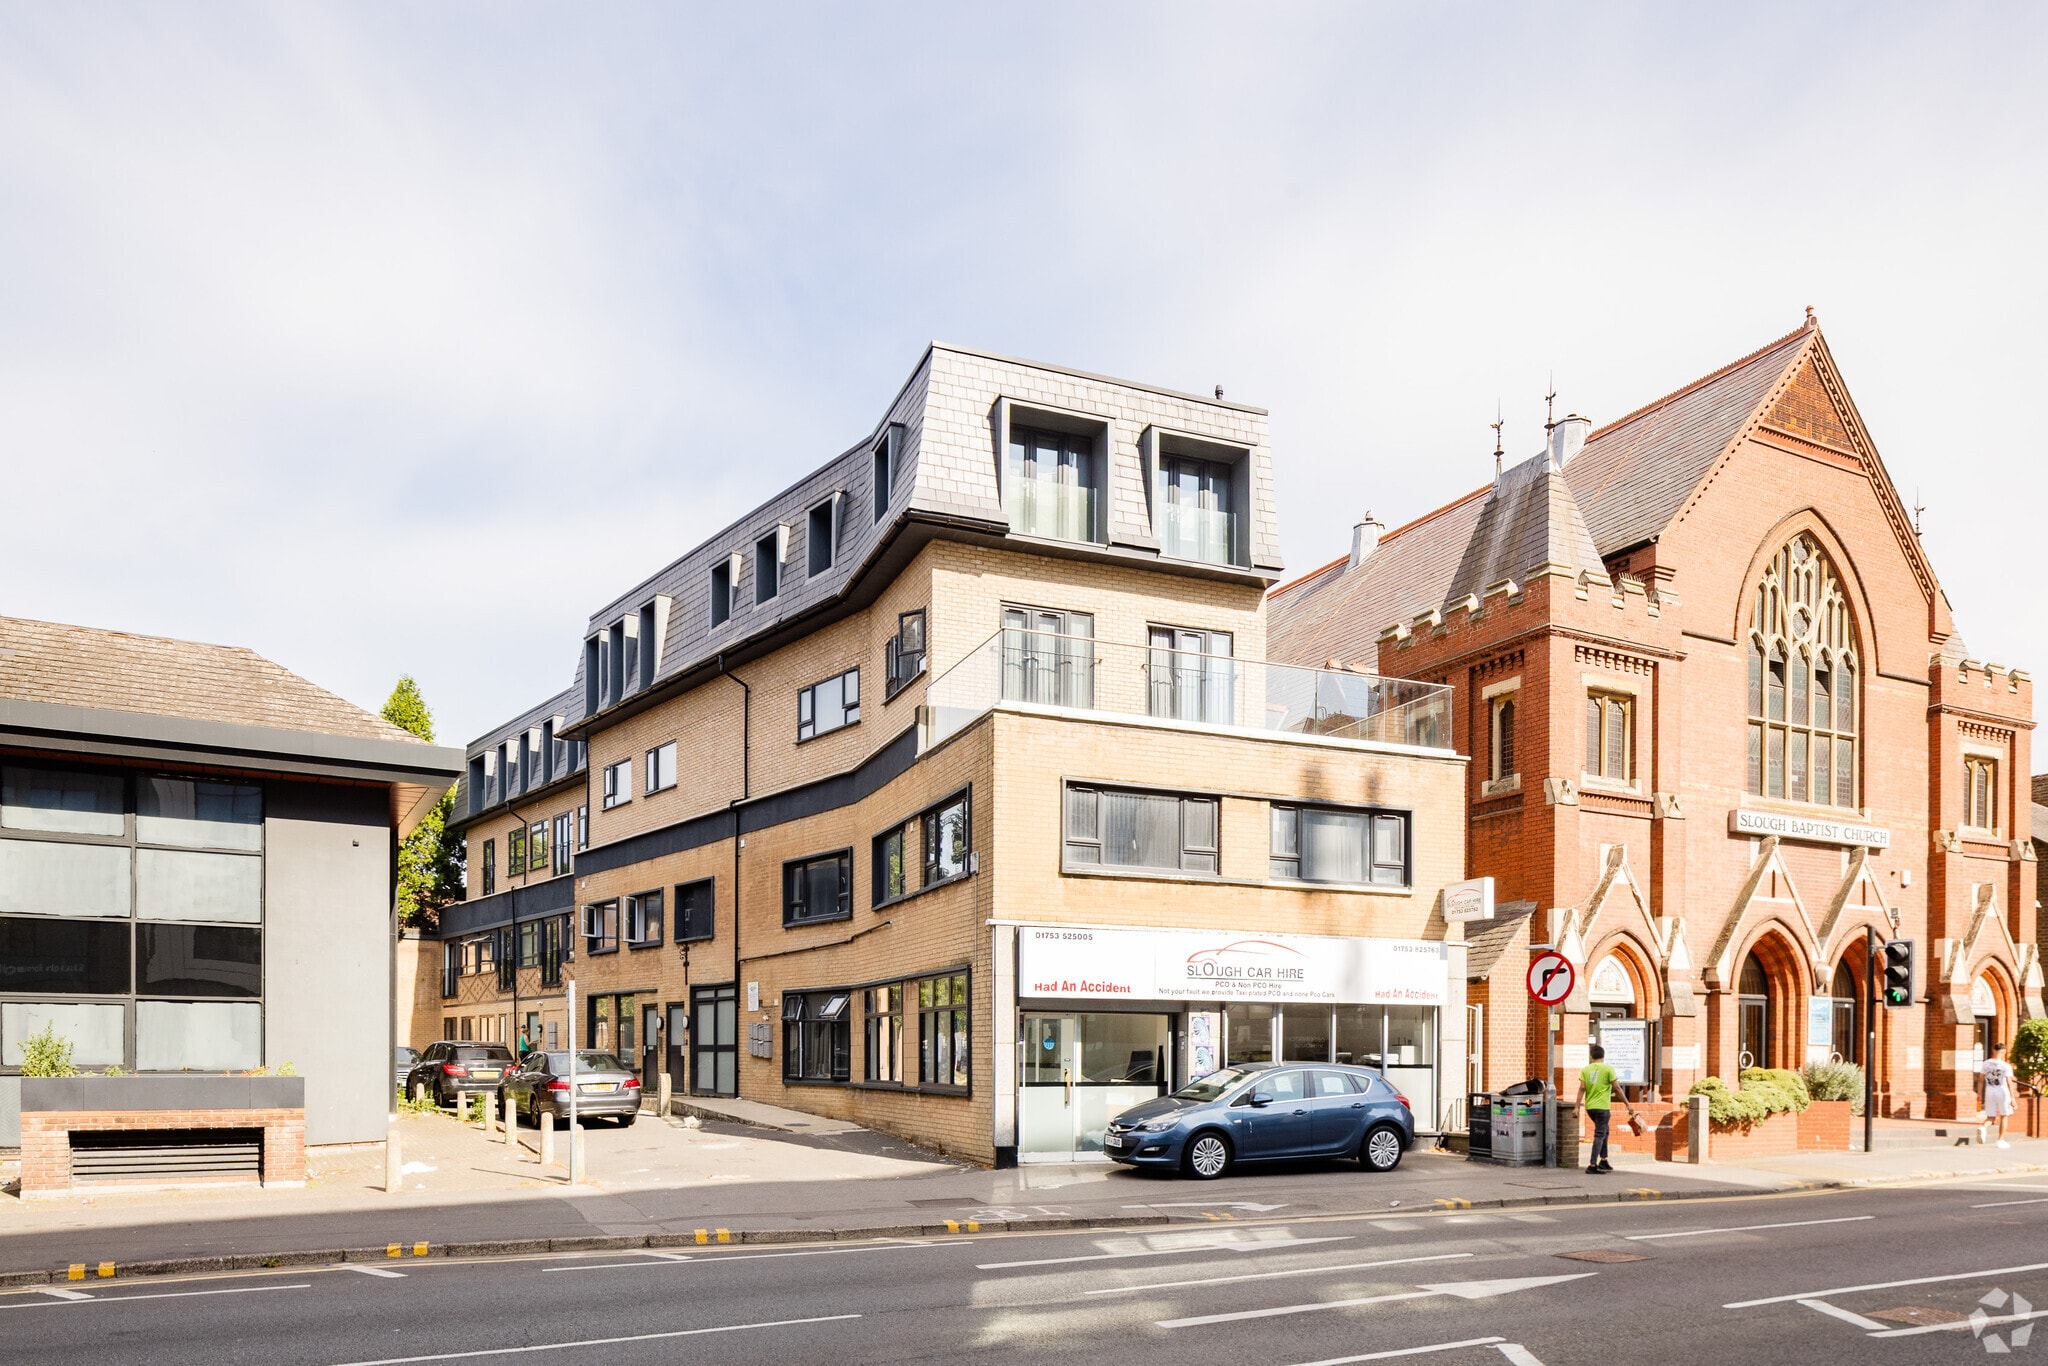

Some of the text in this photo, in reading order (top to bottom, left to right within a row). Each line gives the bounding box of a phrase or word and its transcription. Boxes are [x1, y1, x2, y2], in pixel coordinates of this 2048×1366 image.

[1740, 814, 1888, 844] SLOUGH BAPTIST CHURCH
[1035, 931, 1093, 941] 01753 525005
[1393, 945, 1413, 953] 01753
[1187, 962, 1304, 979] SLOUGH CAR HIRE
[1034, 980, 1131, 994] Had An Accident
[1375, 989, 1439, 1000] Had An Accident
